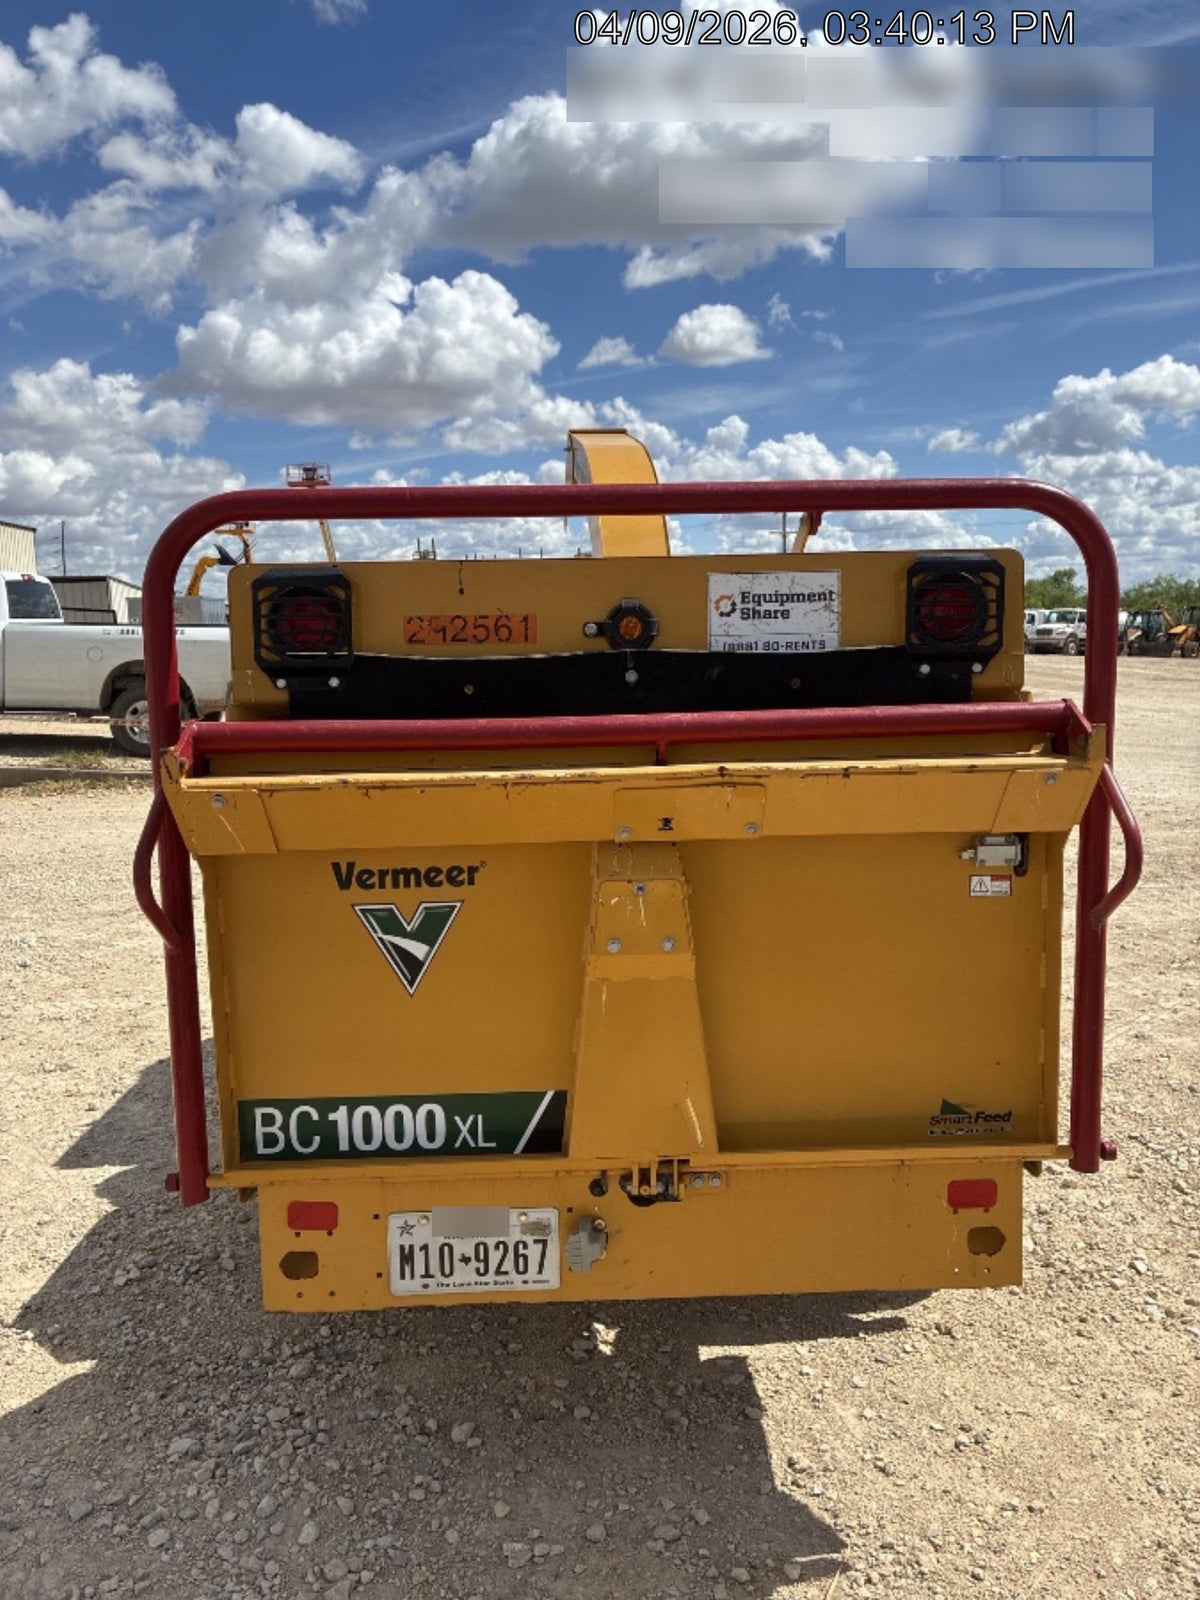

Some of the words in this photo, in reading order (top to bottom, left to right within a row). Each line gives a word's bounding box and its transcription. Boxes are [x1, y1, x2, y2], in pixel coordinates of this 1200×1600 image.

[740, 590, 836, 606] Equipment
[740, 607, 790, 620] Share
[331, 861, 480, 890] Vermeer
